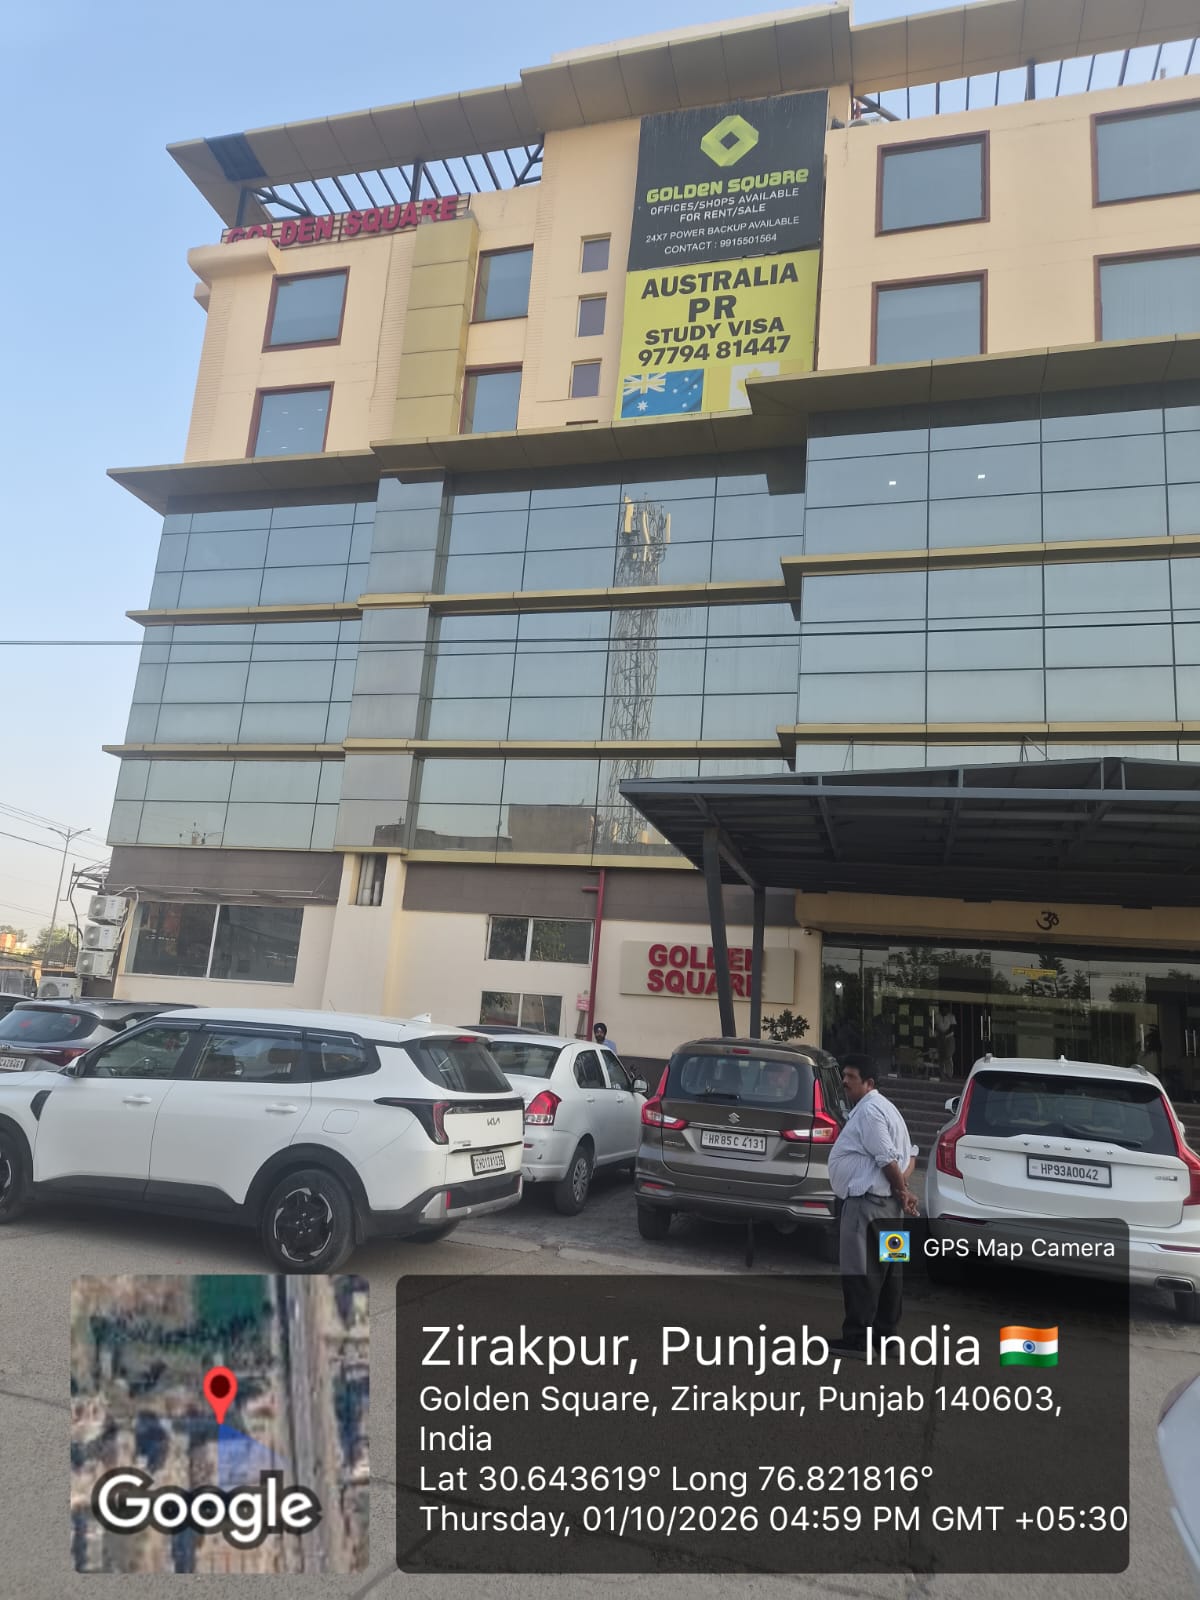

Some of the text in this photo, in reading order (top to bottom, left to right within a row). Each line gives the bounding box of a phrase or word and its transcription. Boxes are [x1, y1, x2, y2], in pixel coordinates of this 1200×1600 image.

[343, 195, 459, 237] SQUARE
[650, 187, 799, 216] OFFICES/SHOPS AVAILABLE
[680, 203, 766, 223] FOR RENT/SALE
[669, 228, 705, 240] POWER
[707, 222, 747, 235] BACKUP
[748, 216, 800, 229] AVAILABLE
[664, 240, 711, 255] CONTACT
[719, 233, 777, 248] 9915501564
[641, 262, 799, 299] AUSTRALIA
[688, 294, 737, 323] PR
[644, 316, 785, 346] STUDY VISA
[638, 334, 791, 367] 97794 81447
[708, 1133, 720, 1145] HR
[721, 1134, 732, 1146] 85
[741, 1136, 764, 1150] 4131
[1040, 1162, 1099, 1181] HP93A0042
